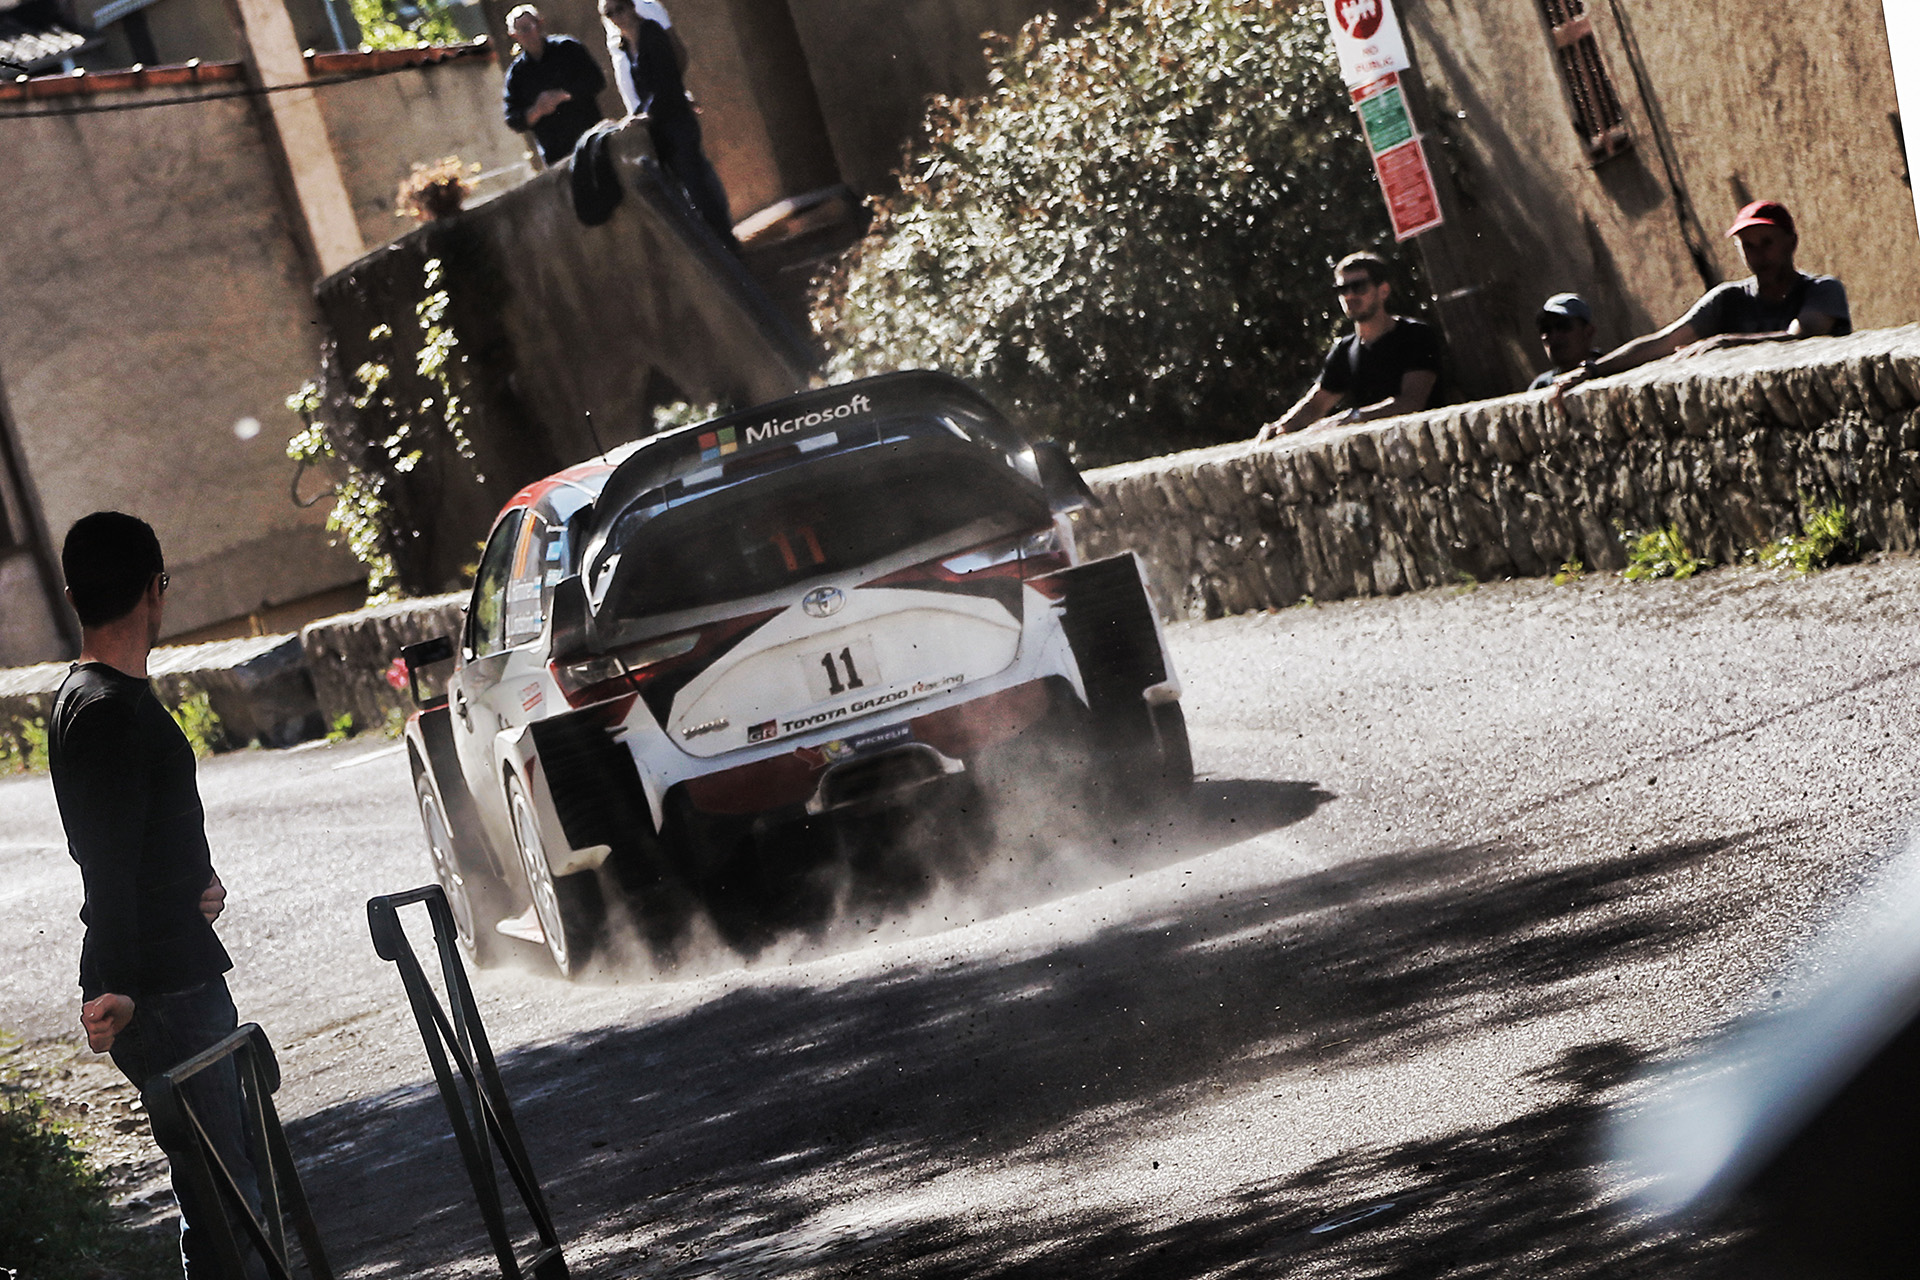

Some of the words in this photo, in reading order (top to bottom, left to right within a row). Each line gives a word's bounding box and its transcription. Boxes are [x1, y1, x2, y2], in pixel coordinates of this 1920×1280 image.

[745, 394, 872, 445] Microsoft
[768, 525, 826, 572] 11
[821, 646, 864, 696] 11
[782, 706, 848, 733] TOYOTA
[851, 689, 909, 713] GAZOO
[911, 673, 965, 696] Racing
